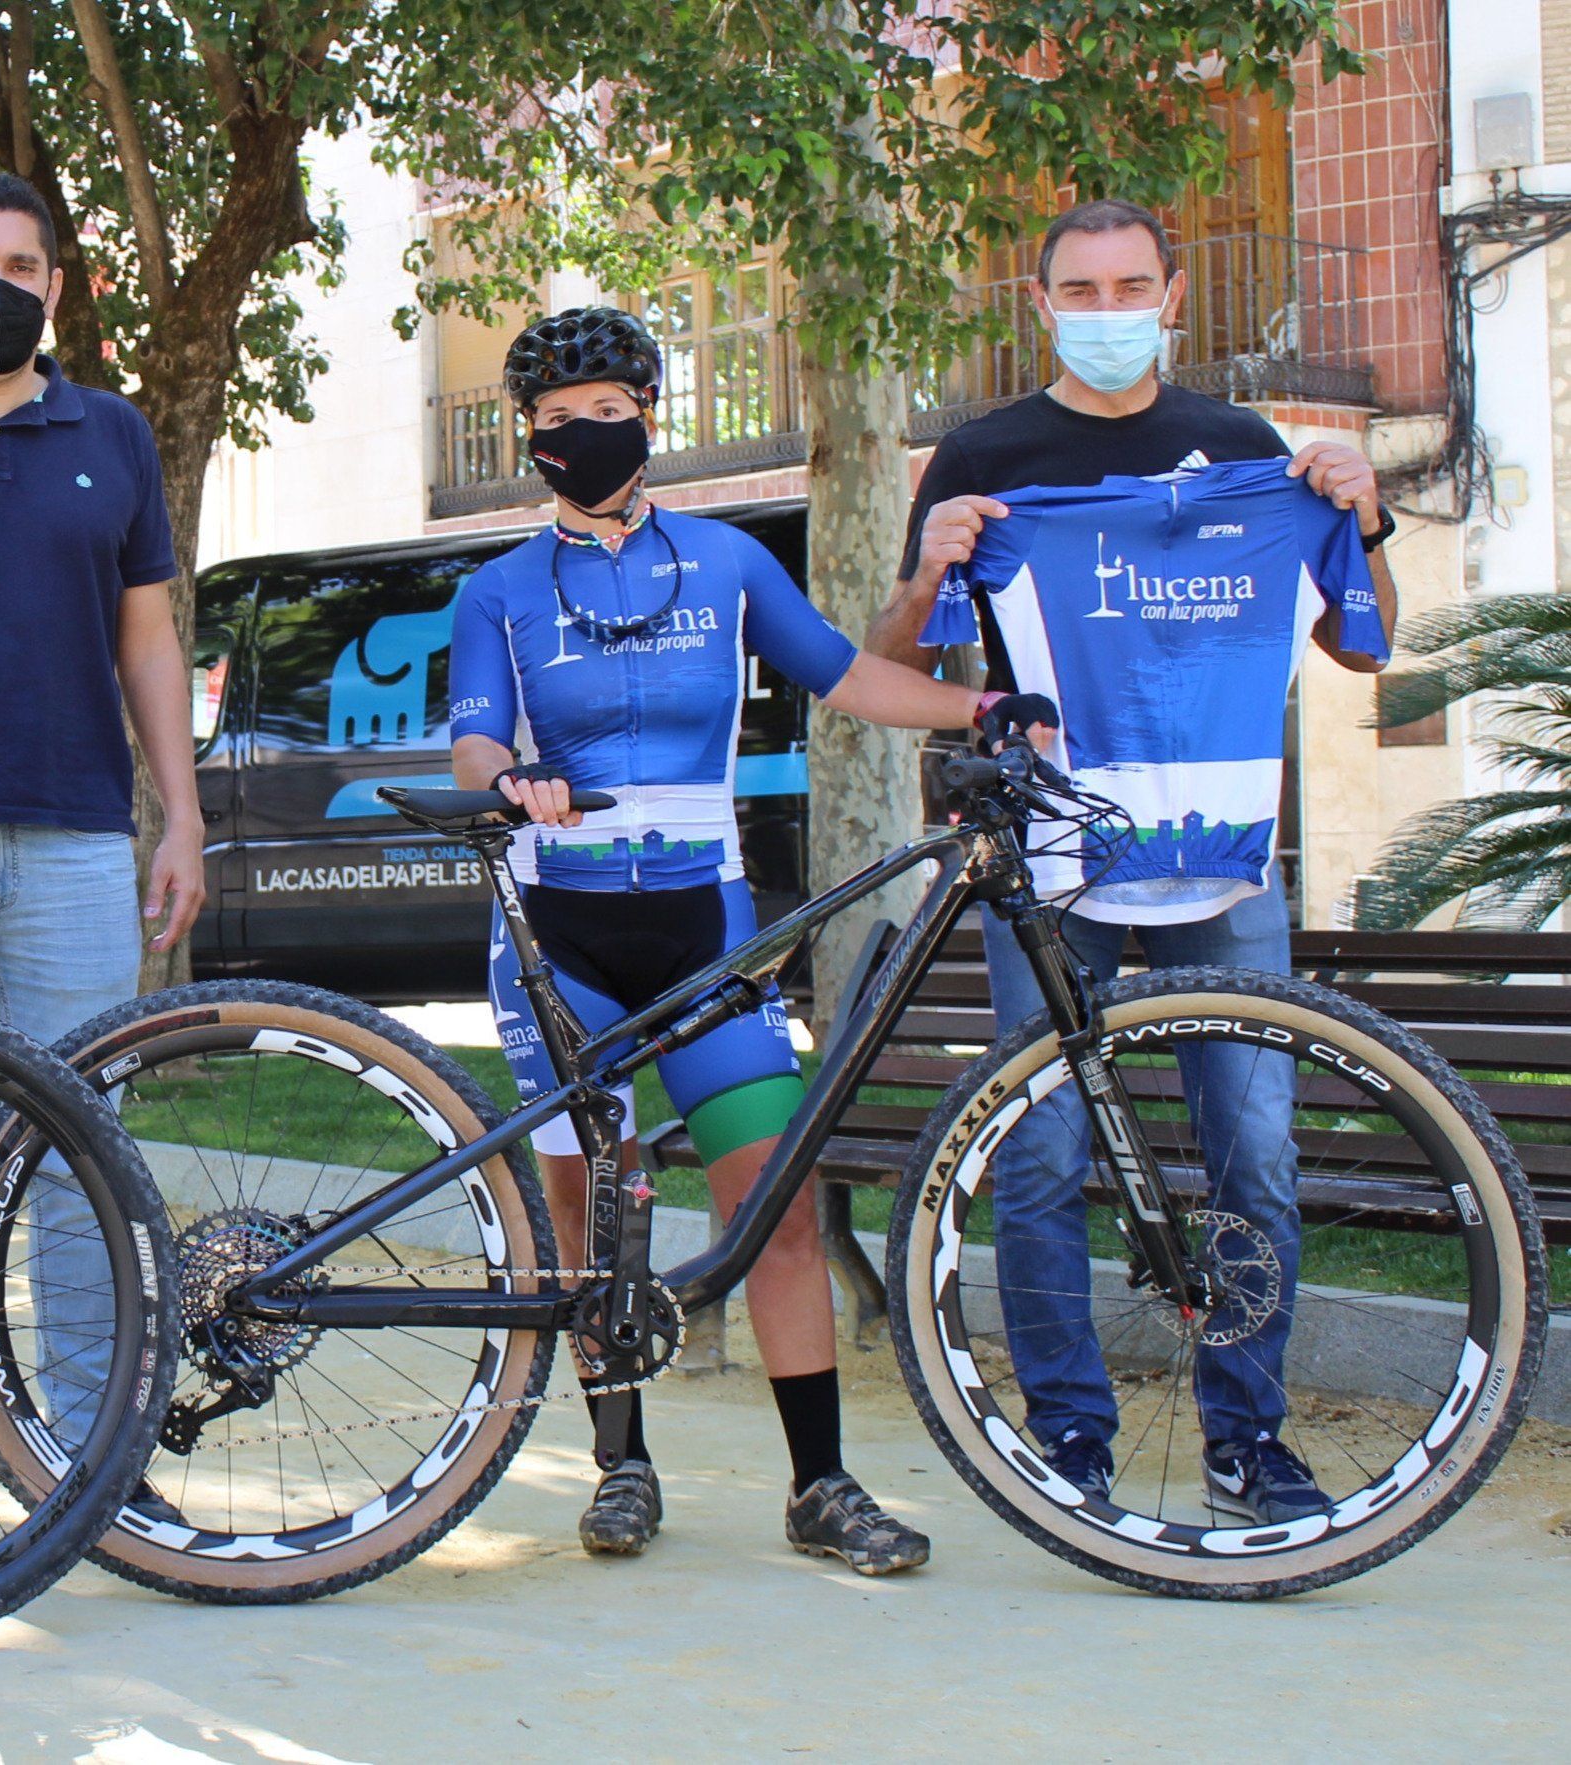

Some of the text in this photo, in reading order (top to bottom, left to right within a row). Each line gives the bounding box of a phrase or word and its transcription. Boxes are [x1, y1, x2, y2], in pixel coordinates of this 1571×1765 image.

[1125, 564, 1256, 601] lucena
[1140, 600, 1239, 623] con luz propia
[632, 637, 654, 653] luz
[656, 631, 705, 655] propia
[383, 848, 427, 863] TIENDA
[256, 862, 482, 893] LACASADELPAPEL.ES
[872, 909, 926, 1008] CONWAY
[1125, 1018, 1392, 1093] WORLD CUP
[922, 1080, 1006, 1213] MAXXIS
[130, 1220, 159, 1302] ARDENT
